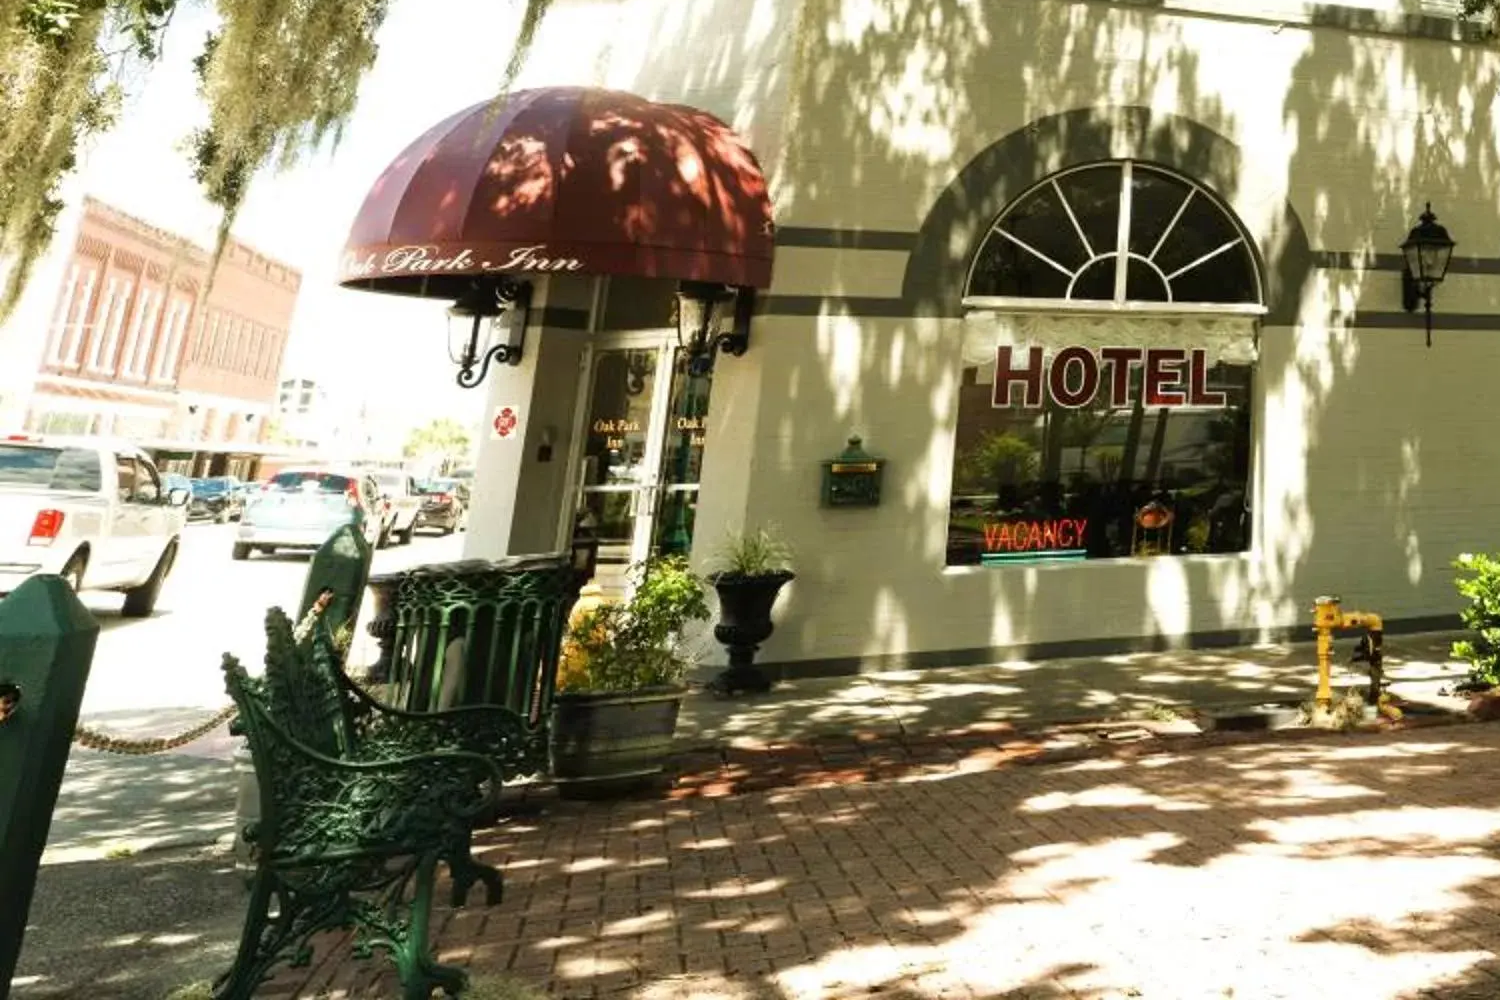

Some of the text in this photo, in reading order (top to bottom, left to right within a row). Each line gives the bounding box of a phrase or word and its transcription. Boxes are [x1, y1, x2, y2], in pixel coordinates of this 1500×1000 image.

[381, 245, 475, 273] Park
[481, 245, 584, 271] Inn
[991, 344, 1227, 409] HOTEL
[594, 419, 640, 433] Oak Park
[678, 417, 699, 430] Oak
[983, 518, 1088, 552] VACANCY
